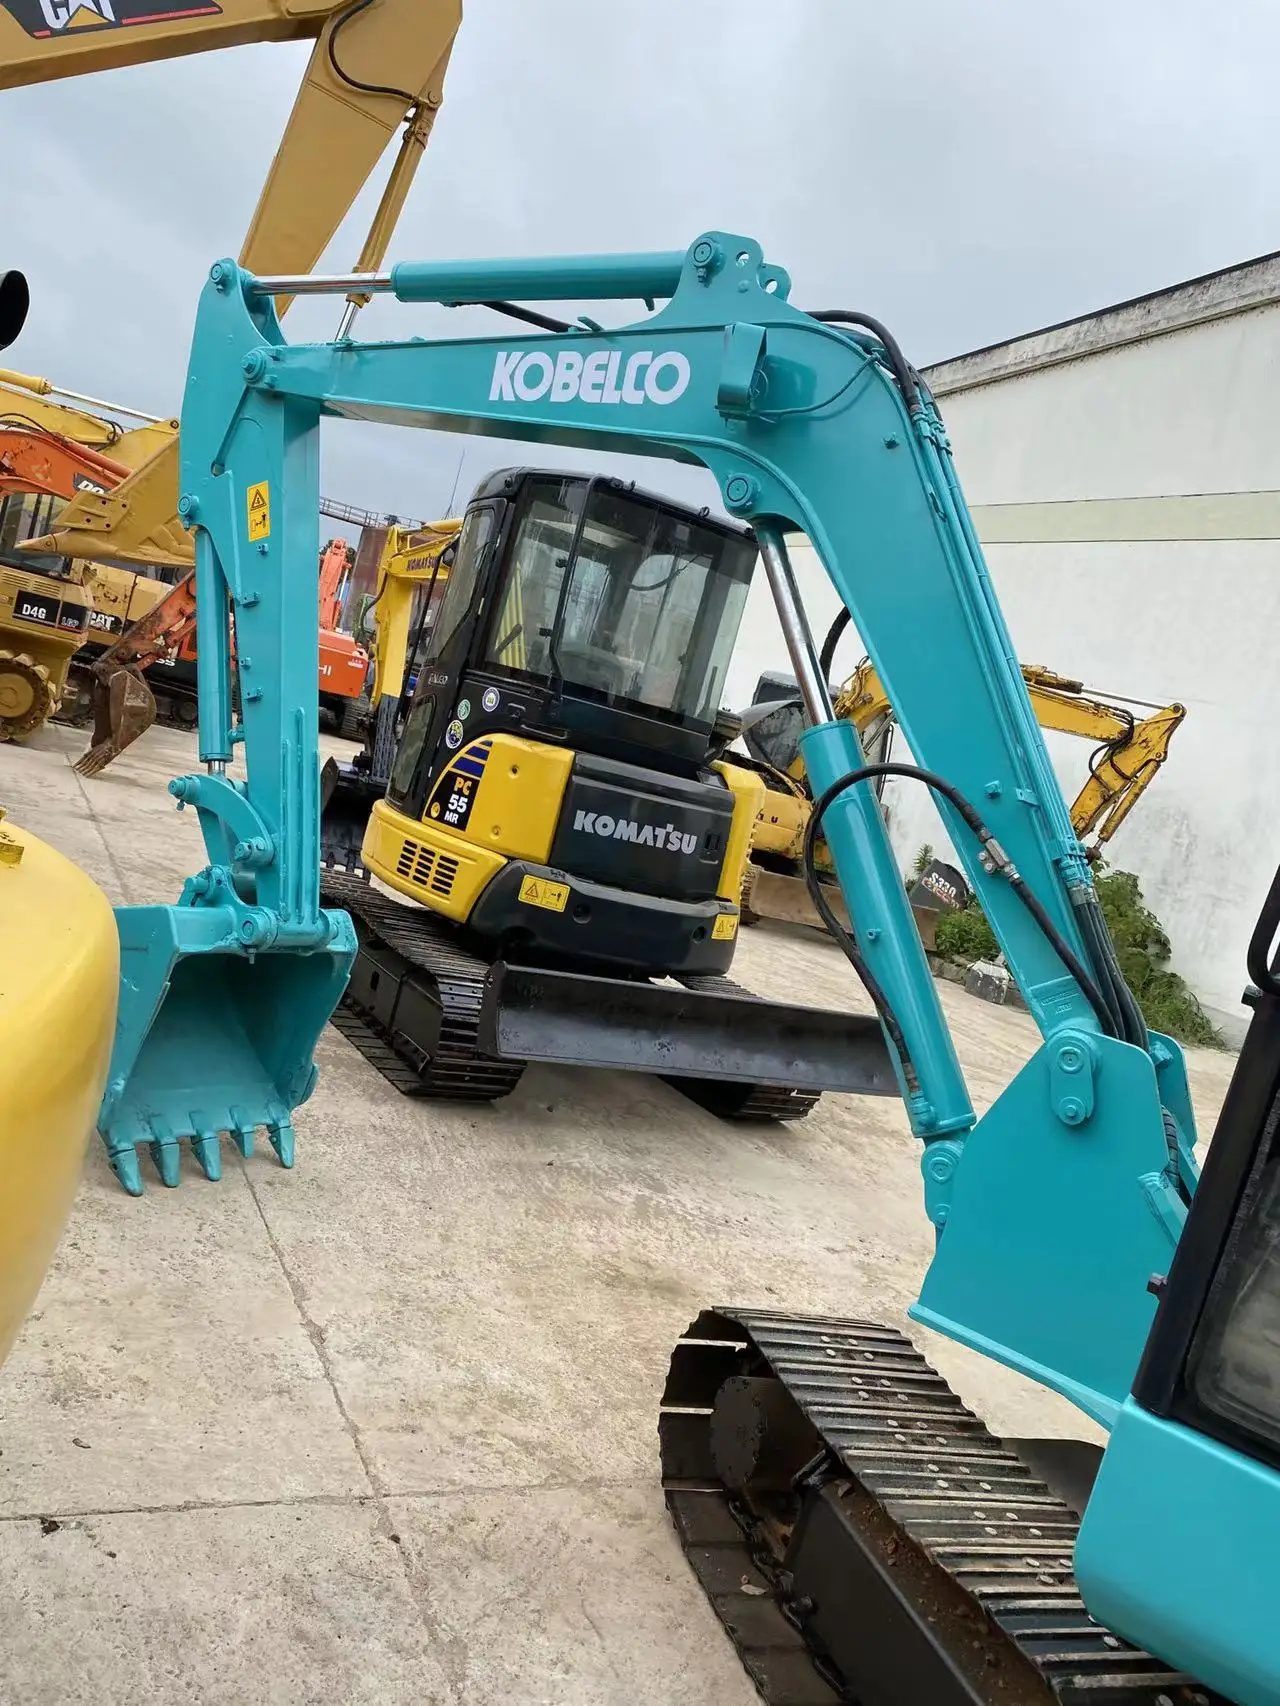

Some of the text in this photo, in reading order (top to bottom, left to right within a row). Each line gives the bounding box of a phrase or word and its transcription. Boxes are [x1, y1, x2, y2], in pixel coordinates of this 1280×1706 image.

[488, 350, 691, 405] KOBELCO
[22, 603, 47, 619] D4G
[453, 776, 473, 796] PC
[447, 794, 469, 813] 55
[443, 810, 459, 825] MR
[573, 809, 698, 856] KOMATSU
